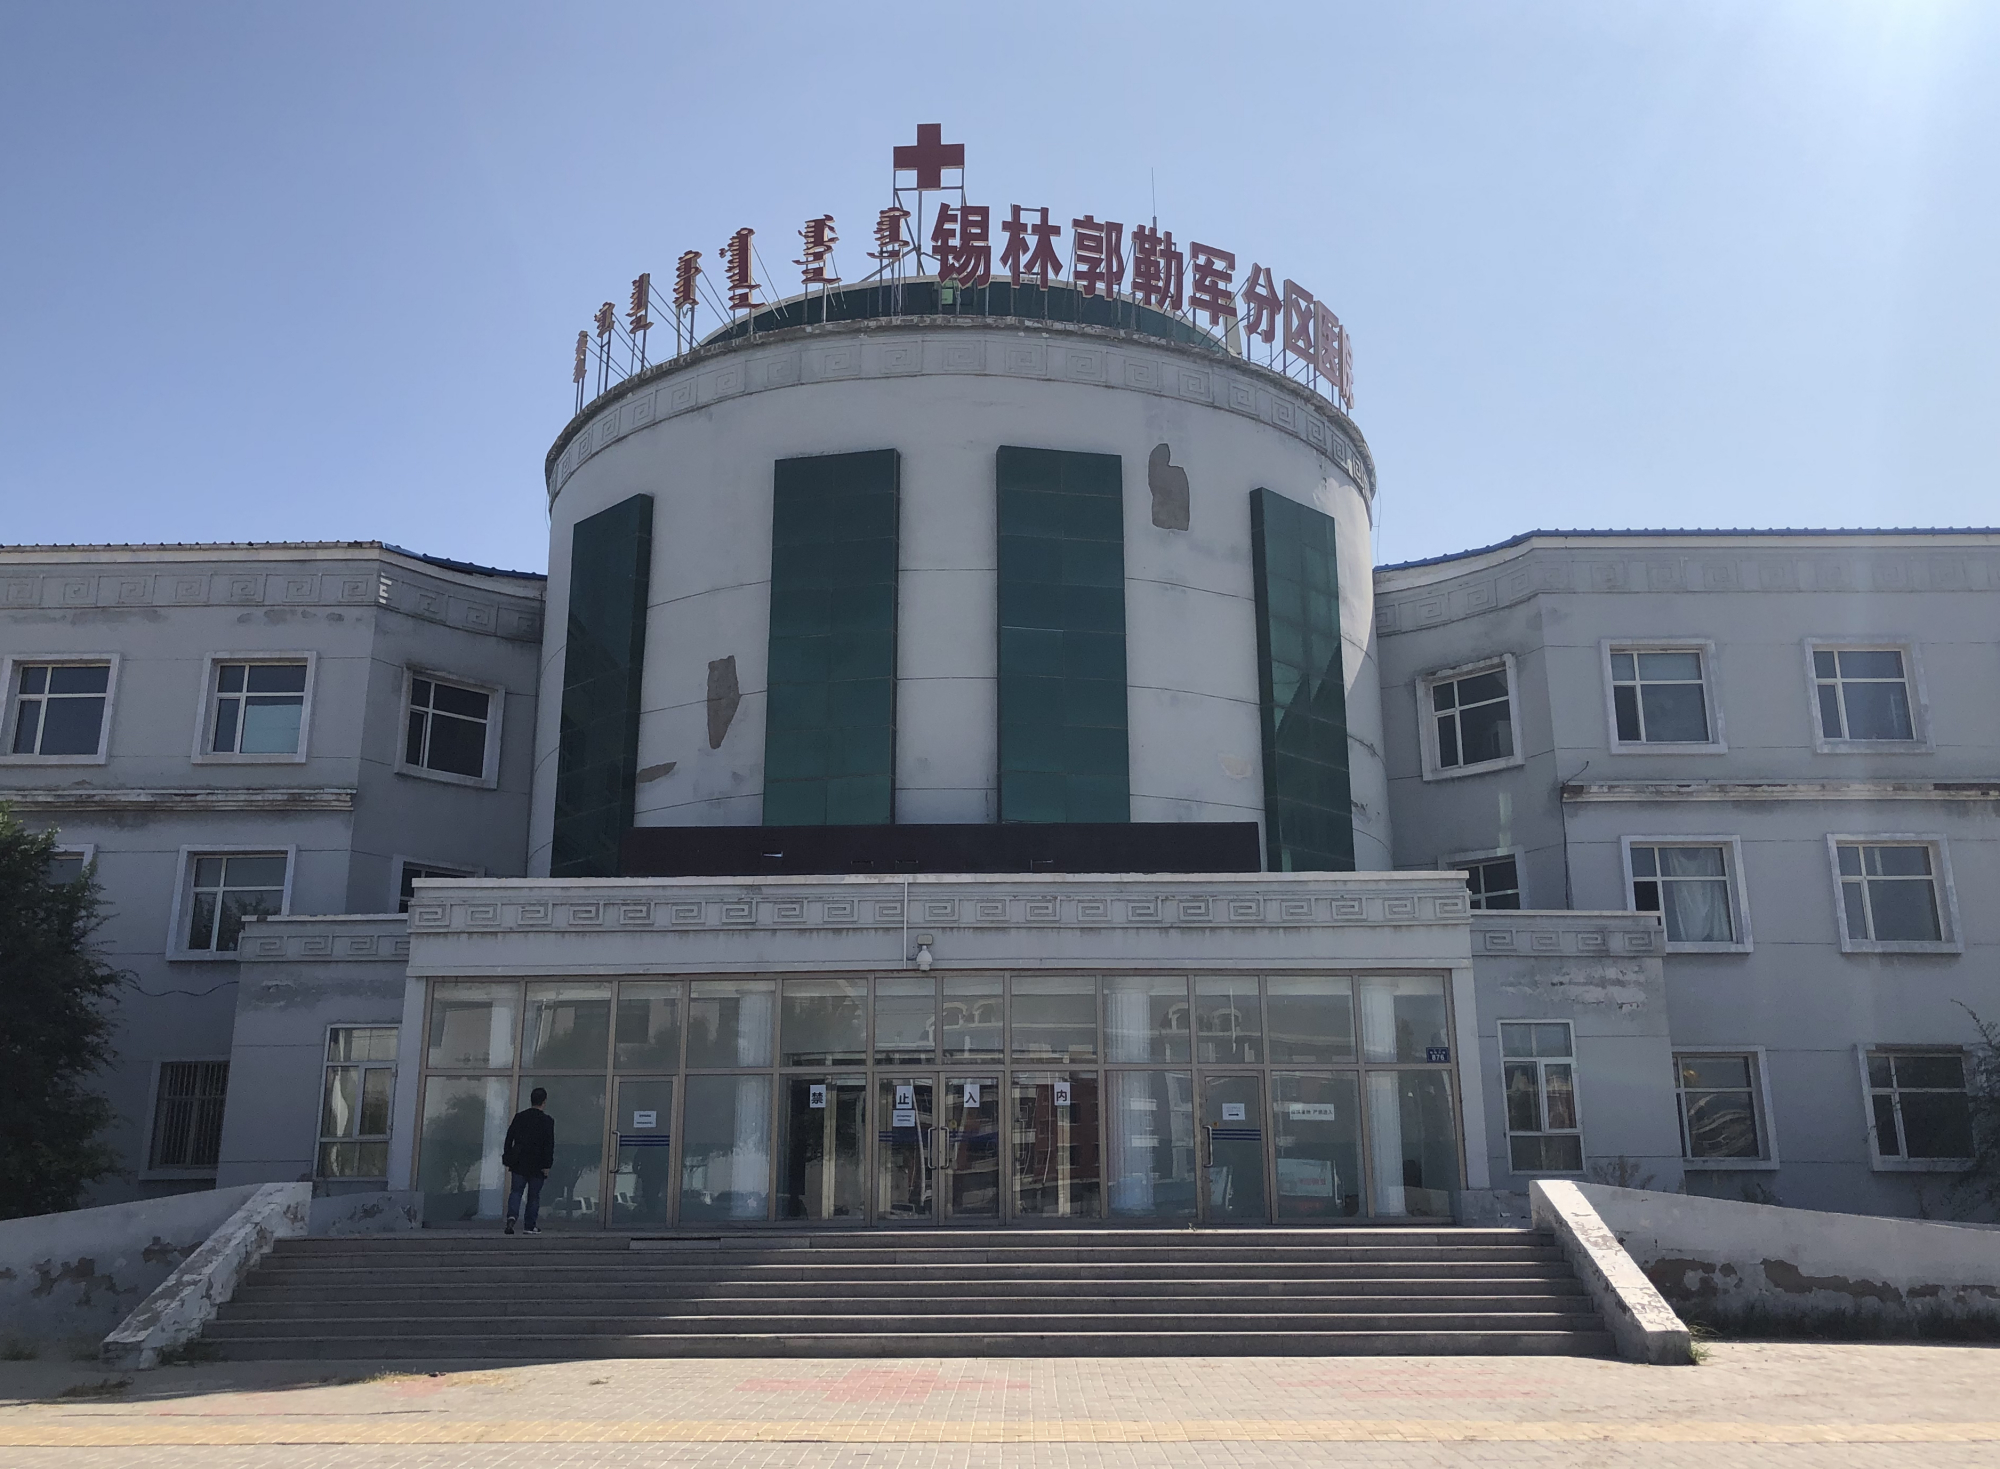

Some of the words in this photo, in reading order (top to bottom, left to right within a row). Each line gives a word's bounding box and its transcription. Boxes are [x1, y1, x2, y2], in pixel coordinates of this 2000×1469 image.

[811, 1091, 824, 1104] 禁
[898, 1092, 909, 1105] 止
[965, 1092, 977, 1104] 入
[1055, 1090, 1068, 1102] 内
